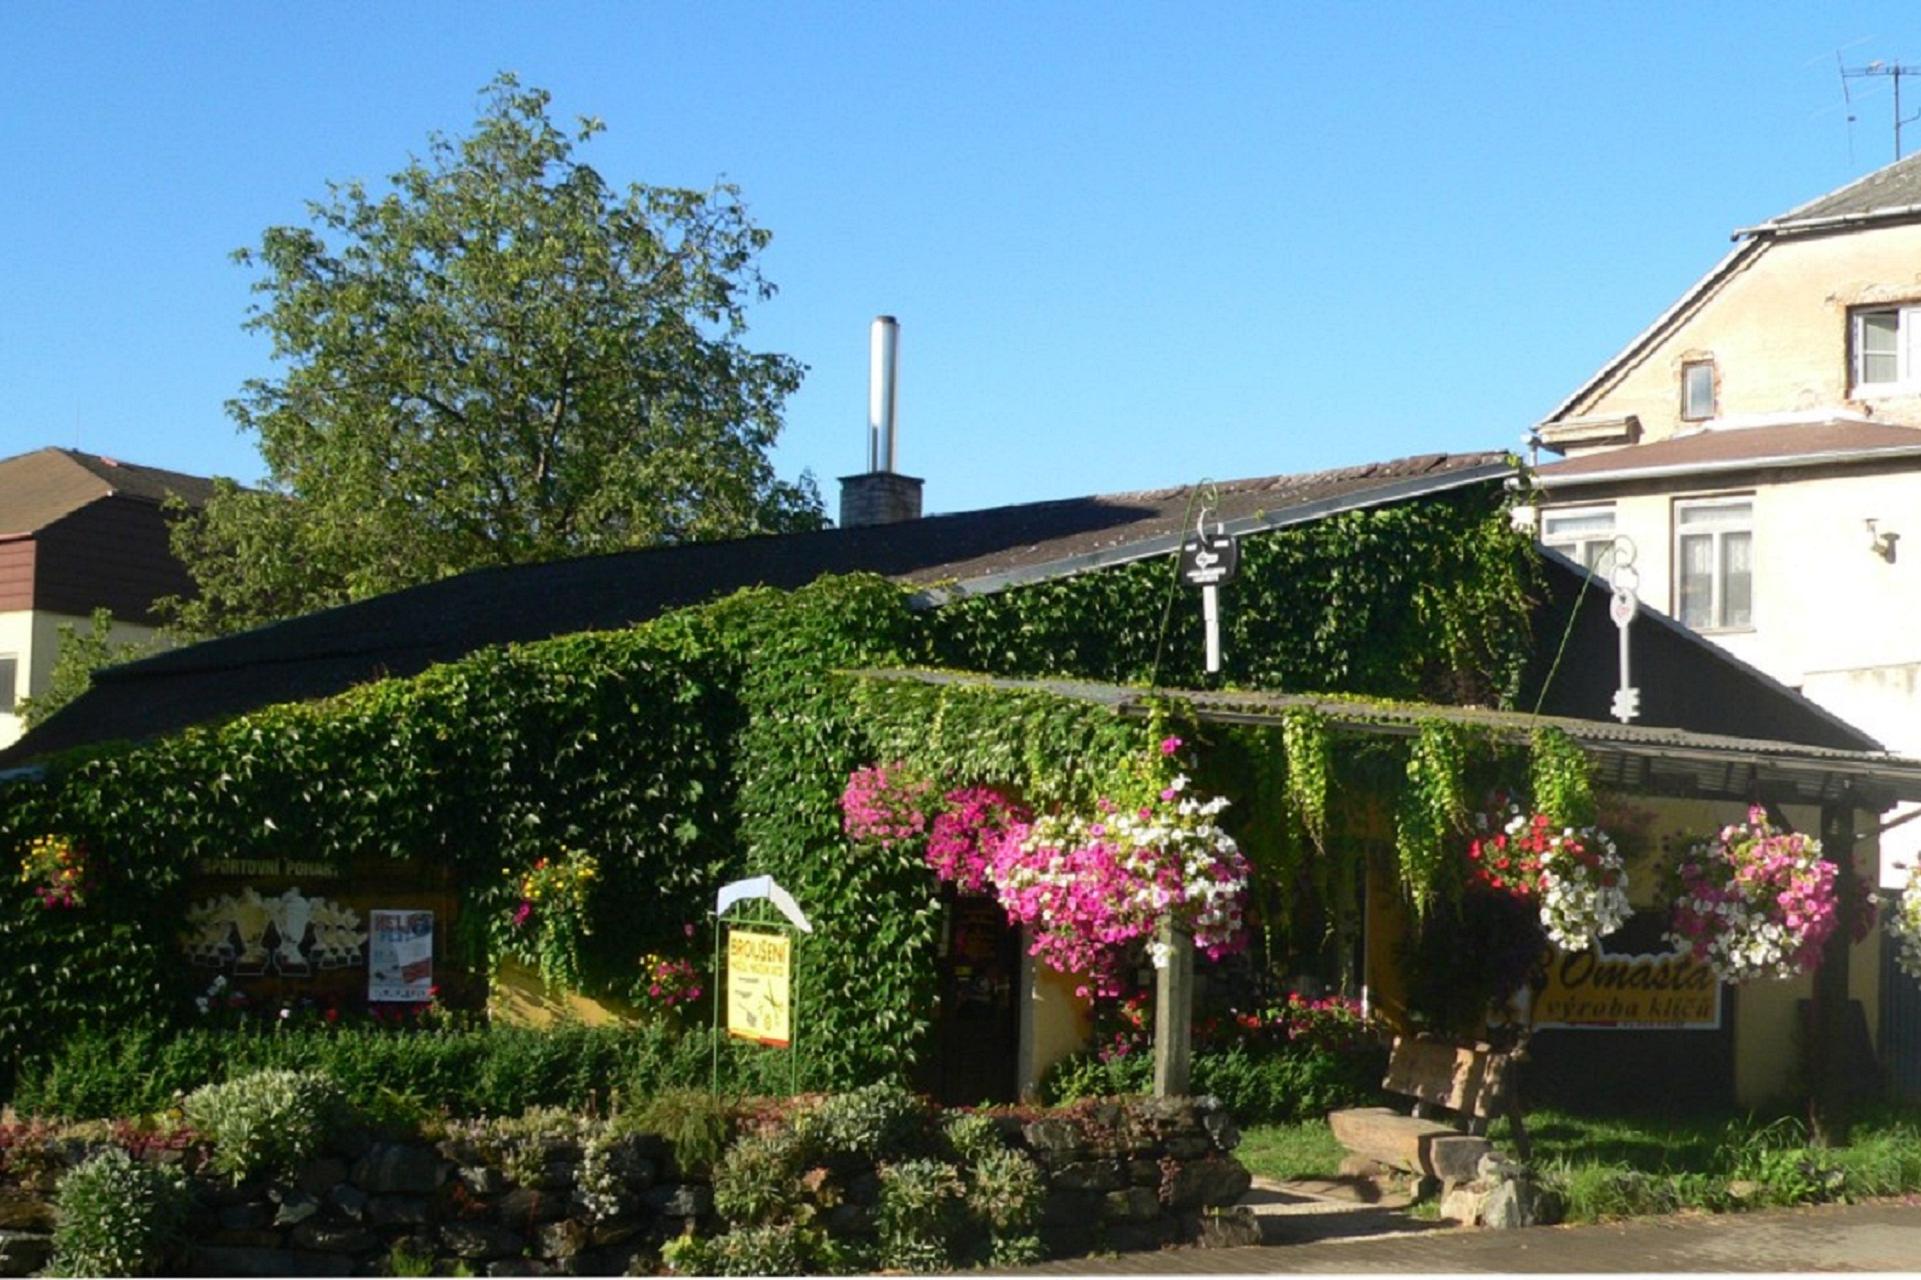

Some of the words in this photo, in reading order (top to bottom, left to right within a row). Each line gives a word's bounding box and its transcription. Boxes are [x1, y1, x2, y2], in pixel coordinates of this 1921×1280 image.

[731, 938, 788, 964] BROUŠENÍ
[1560, 949, 1710, 991] Omasta
[1546, 995, 1638, 1019] výroba
[1649, 996, 1711, 1019] klíčů
